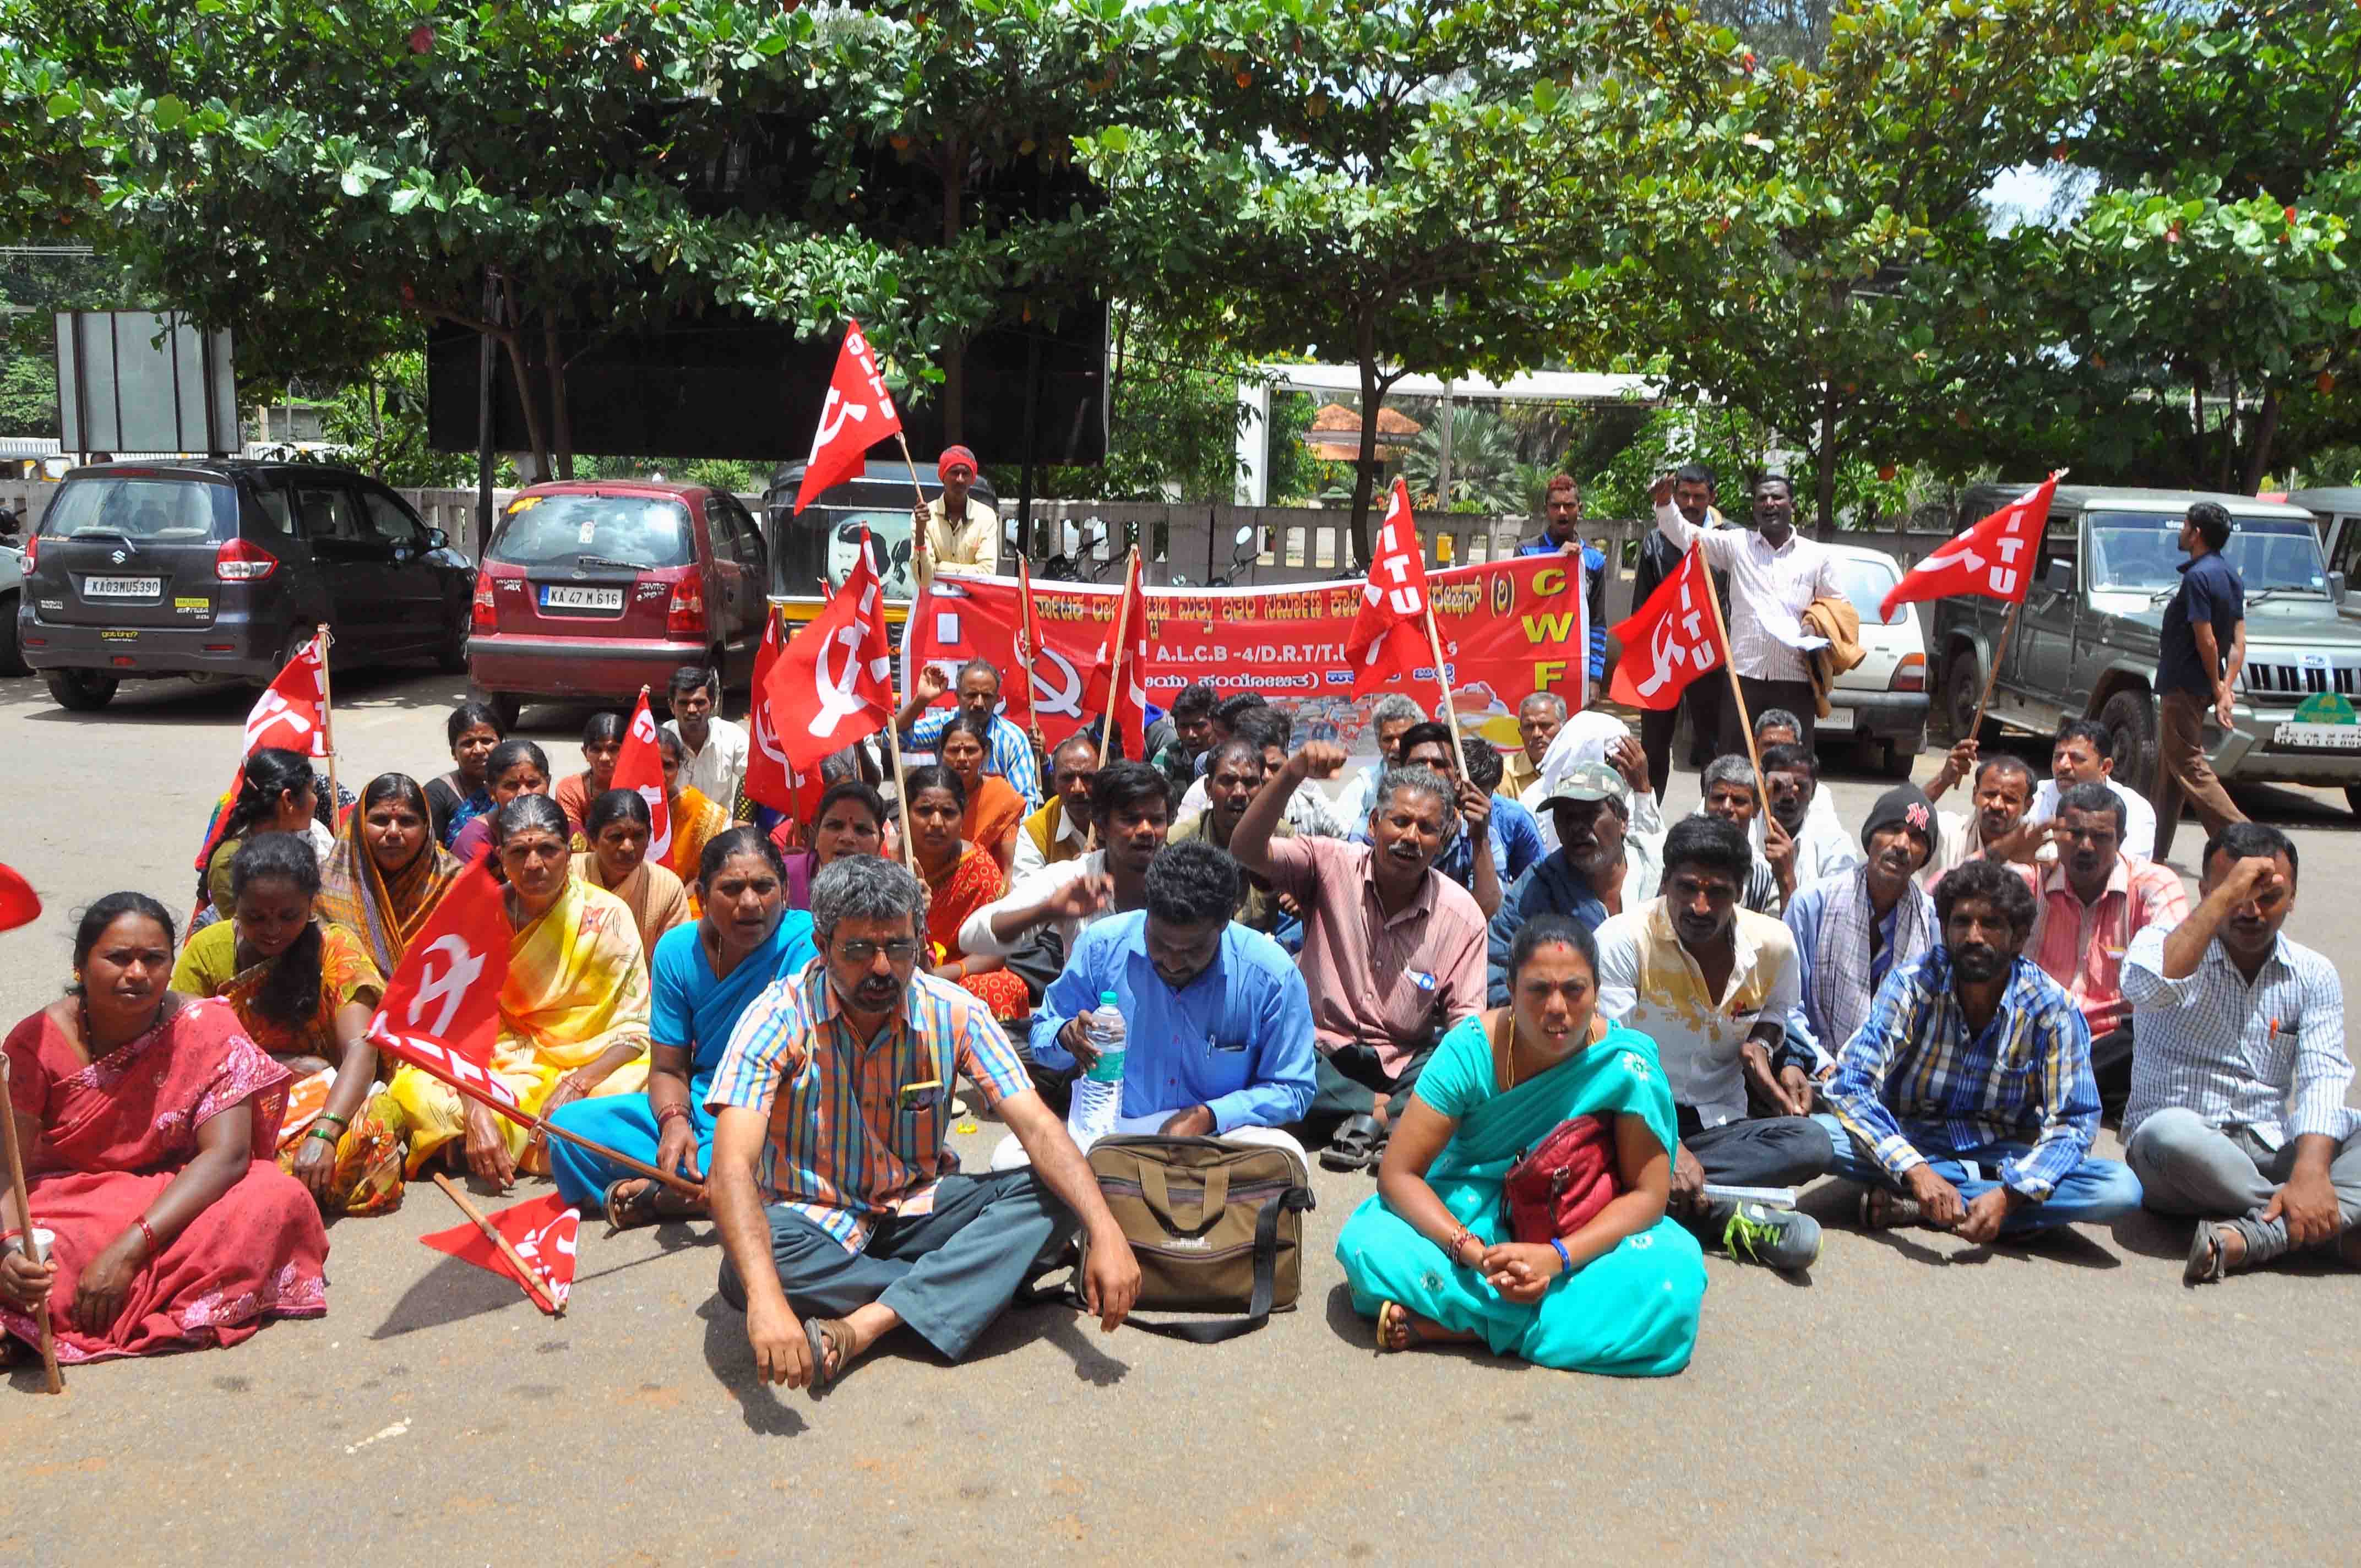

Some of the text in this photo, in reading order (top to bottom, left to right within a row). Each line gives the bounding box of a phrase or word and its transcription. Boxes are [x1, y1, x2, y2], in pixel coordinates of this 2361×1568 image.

[551, 591, 617, 605] KA 47 M 616
[1156, 645, 1227, 662] A.L.C.B
